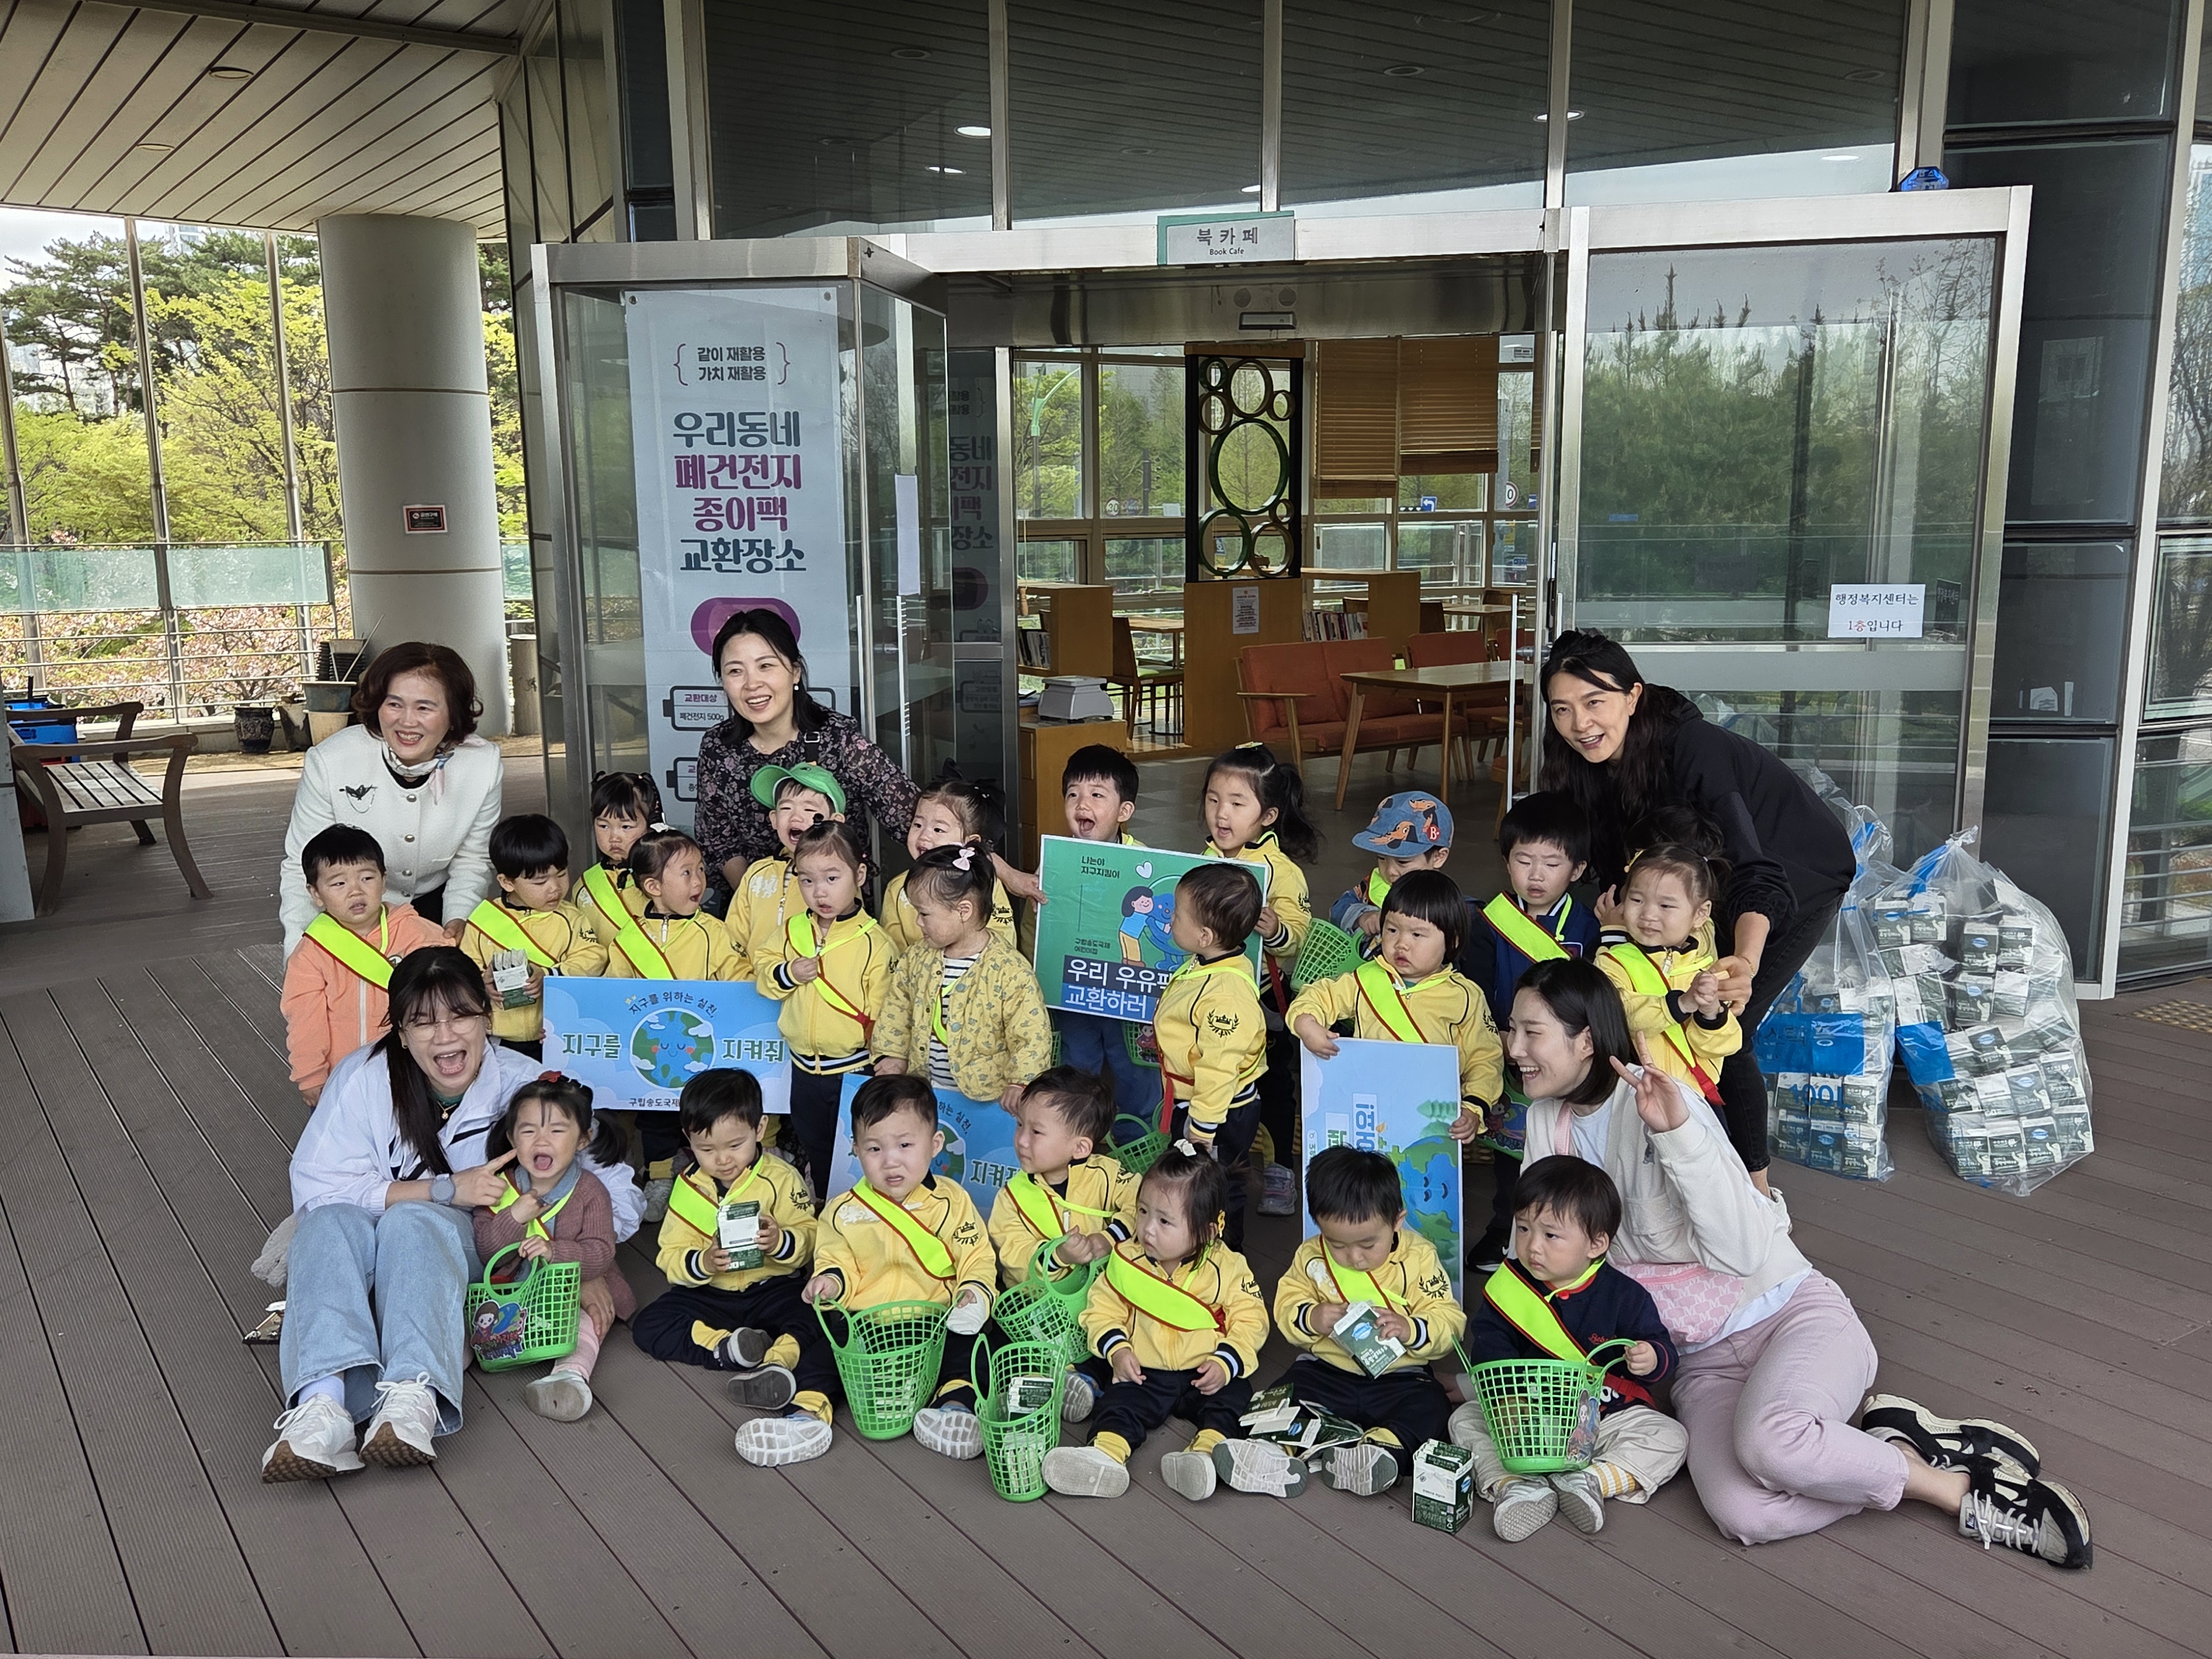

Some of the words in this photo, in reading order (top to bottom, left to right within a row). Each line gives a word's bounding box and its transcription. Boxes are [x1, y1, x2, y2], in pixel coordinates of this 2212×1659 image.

[1197, 227, 1258, 246] 북카페
[697, 347, 723, 362] 같이
[727, 346, 766, 362] 재활용
[699, 366, 724, 382] 가치
[727, 366, 766, 381] 재활용
[673, 411, 801, 448] 우리동네
[674, 454, 802, 490] 폐건전지
[693, 496, 788, 532] 종이팩
[680, 539, 807, 573] 교환장소
[1835, 593, 1919, 606] 행정복지센터는
[1848, 620, 1903, 632] 1층입니다
[684, 694, 717, 702] 교환대상
[1081, 855, 1105, 867] 나는야
[1081, 866, 1120, 879] 지구지킴이
[1068, 959, 1108, 986] 우리
[629, 993, 659, 1015] 지구를
[663, 992, 694, 1004] 위하는
[1065, 985, 1147, 1019] 교환하러
[562, 1033, 621, 1059] 지구를
[722, 1039, 785, 1062] 지켜줘
[938, 1100, 953, 1117] 하는
[1355, 1103, 1375, 1152] 어요!
